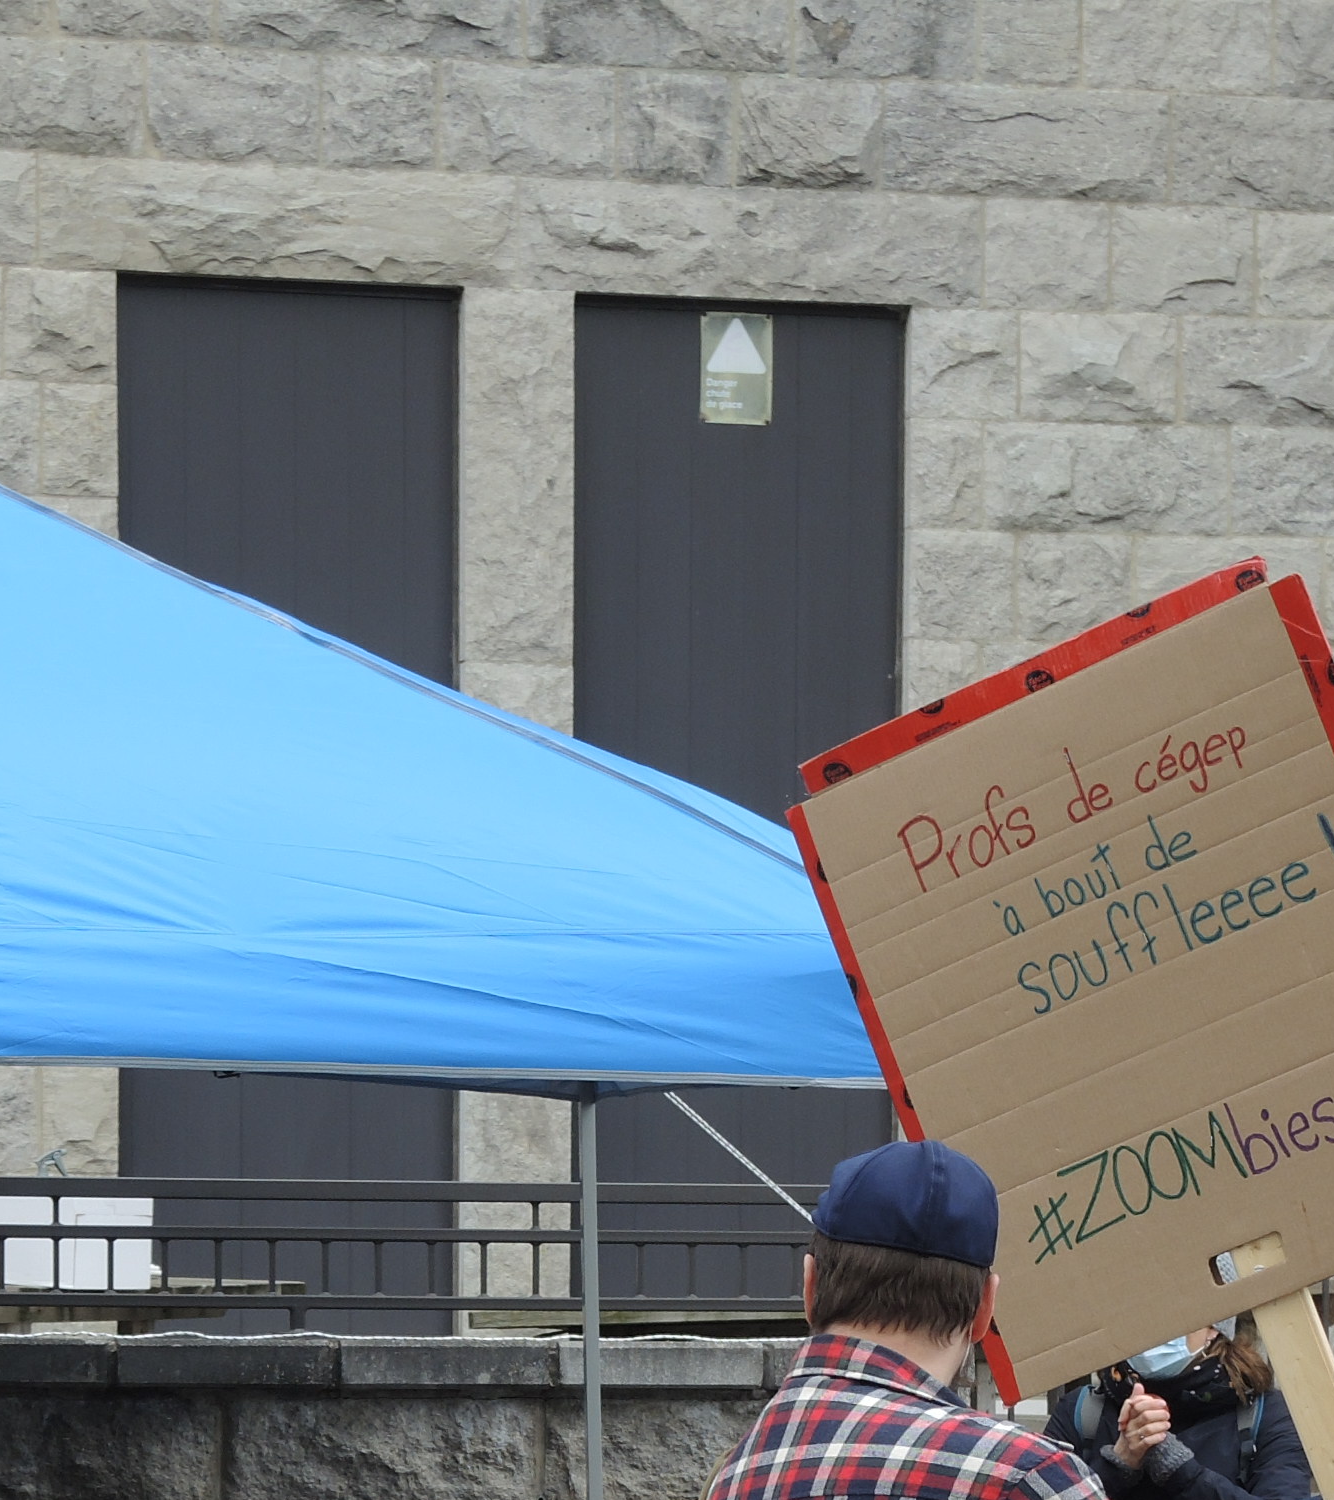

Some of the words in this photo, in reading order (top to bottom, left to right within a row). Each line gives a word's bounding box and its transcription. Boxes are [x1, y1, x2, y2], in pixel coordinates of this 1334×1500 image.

[897, 785, 1036, 893] Profs
[1064, 747, 1114, 824] de
[1134, 726, 1246, 793] cégep
[992, 900, 1026, 936] à
[1034, 843, 1121, 919] bout
[1145, 814, 1199, 871] de
